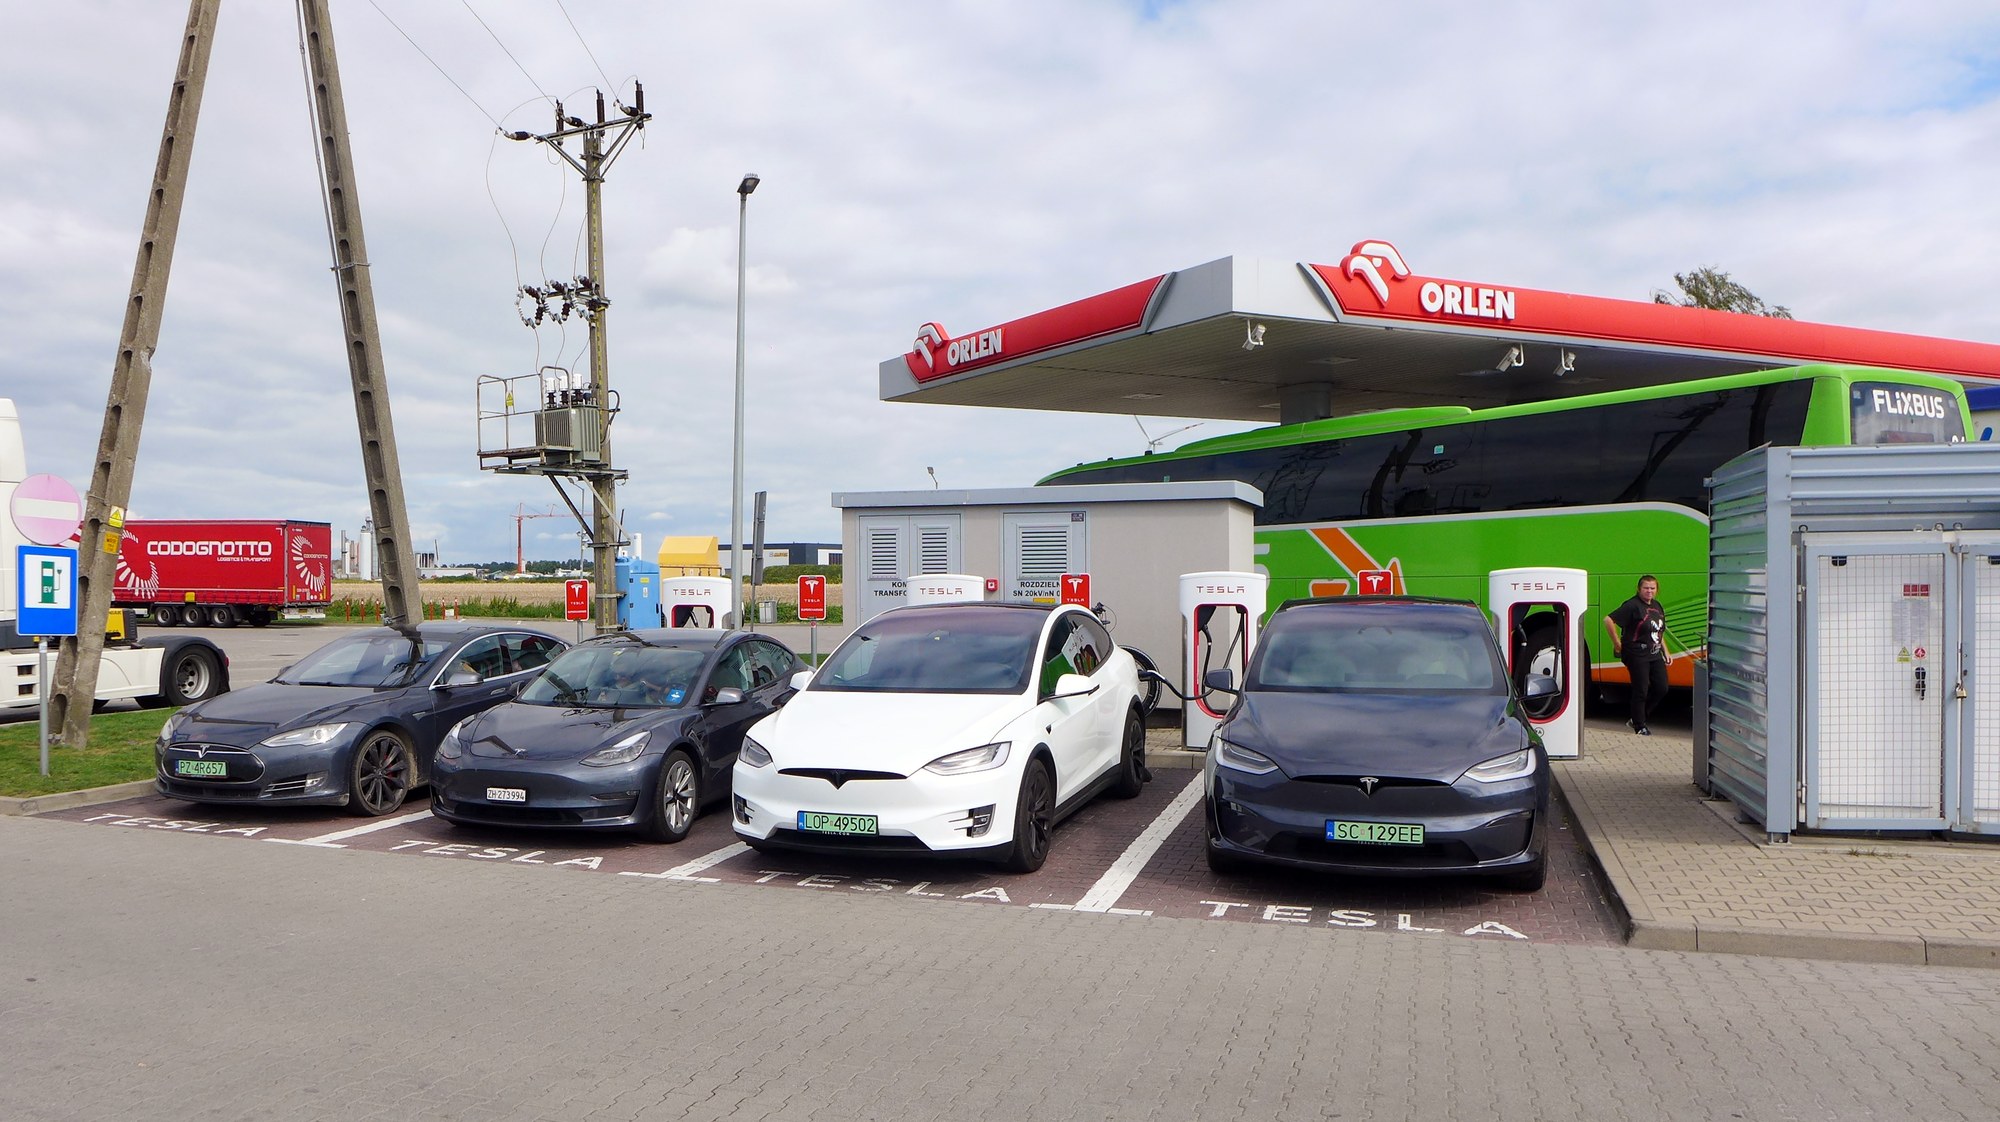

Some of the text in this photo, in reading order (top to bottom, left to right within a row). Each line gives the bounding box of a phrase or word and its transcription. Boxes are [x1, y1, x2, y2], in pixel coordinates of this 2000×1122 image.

[1420, 281, 1516, 320] ORLEN
[947, 328, 1002, 367] ORLEN
[147, 540, 272, 556] CODOGNOTTO
[673, 588, 711, 596] TESLA
[919, 587, 963, 595] TESLA
[1196, 585, 1245, 593] TESLA
[1511, 582, 1566, 591] TESLA
[180, 761, 224, 775] PZ 4R657
[83, 812, 269, 838] TESLA
[805, 814, 875, 833] LOP 49502
[1338, 823, 1421, 842] SC 129EE
[390, 839, 604, 870] TESLA
[754, 869, 1012, 903] TESLA
[1200, 899, 1529, 940] TESLA
